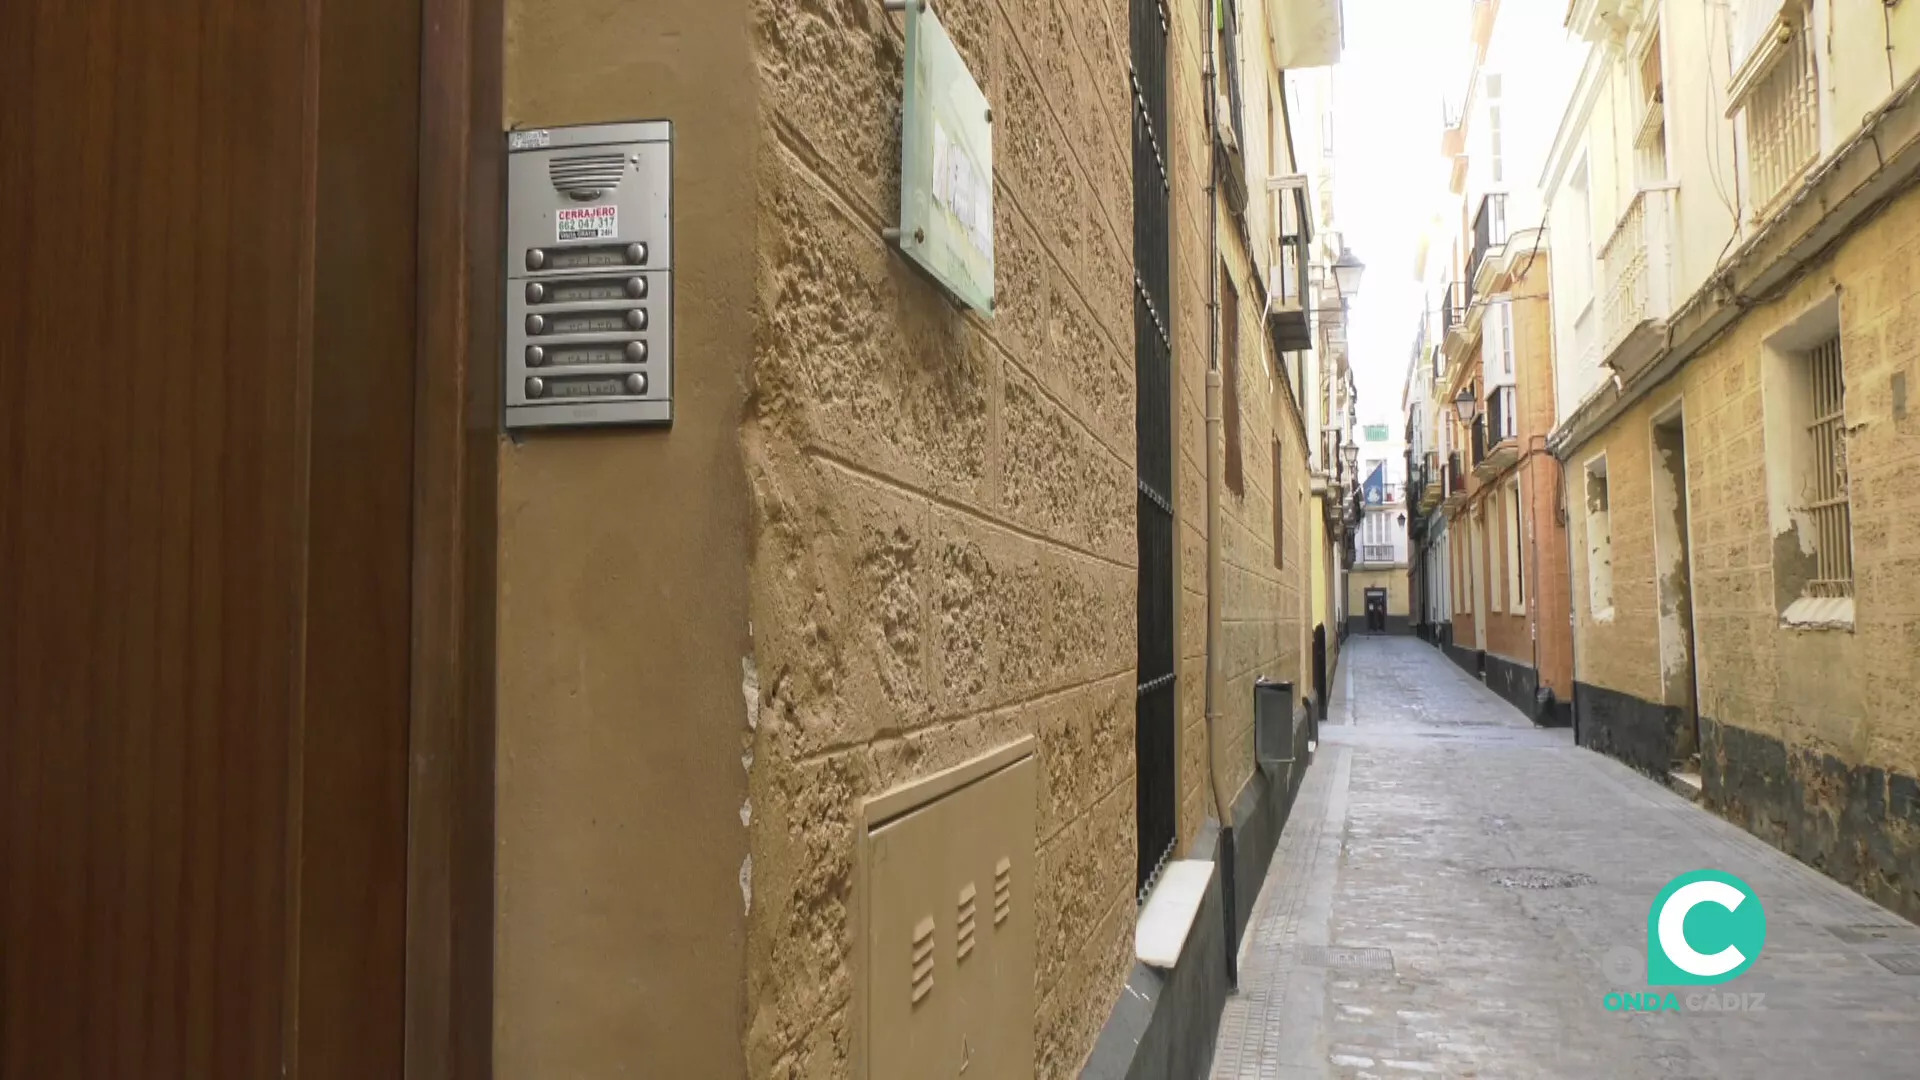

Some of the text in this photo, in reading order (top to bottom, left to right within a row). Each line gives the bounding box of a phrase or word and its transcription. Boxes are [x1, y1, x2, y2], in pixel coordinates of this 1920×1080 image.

[559, 207, 615, 220] CERRAJERO
[559, 217, 614, 231] 662 047 317
